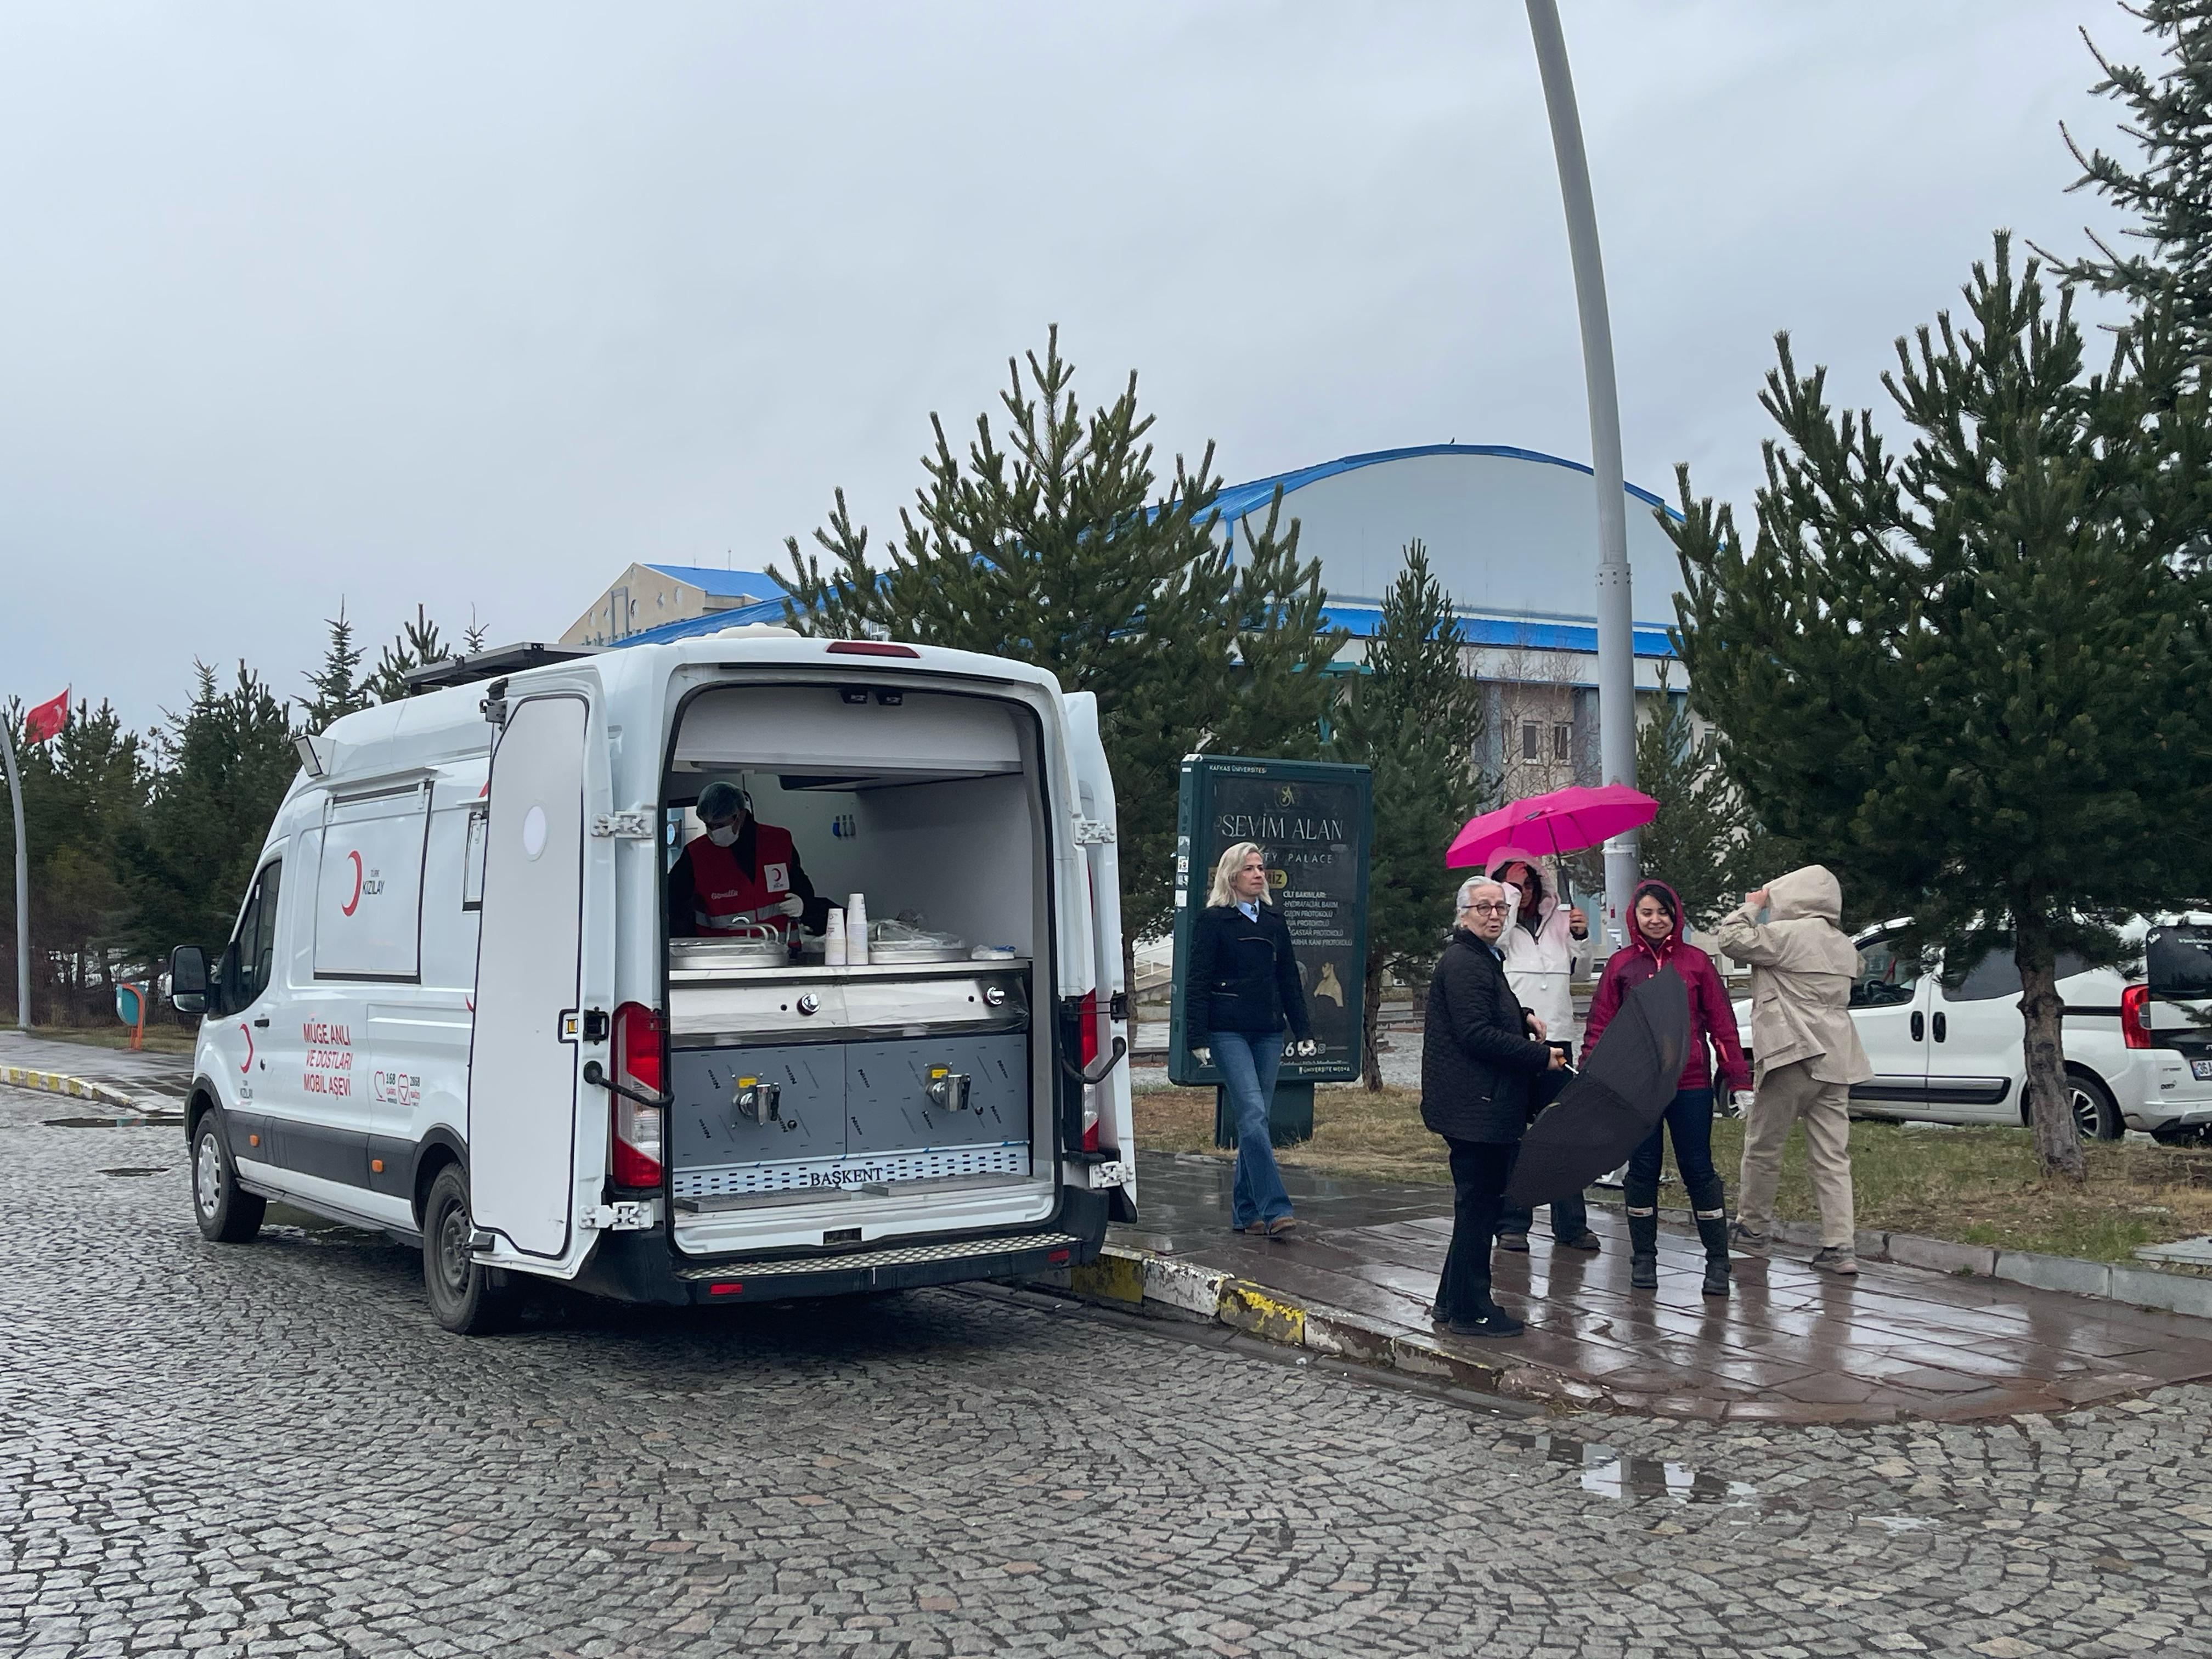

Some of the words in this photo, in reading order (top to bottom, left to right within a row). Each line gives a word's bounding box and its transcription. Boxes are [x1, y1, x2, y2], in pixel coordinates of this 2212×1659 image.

[1221, 813, 1284, 839] SEVİM
[1291, 818, 1344, 840] ALAN
[1289, 853, 1332, 864] PALACE
[363, 880, 385, 895] KIZILAY
[303, 1018, 329, 1045] MÜGE
[331, 1024, 352, 1046] ANLI
[306, 1049, 316, 1067] VE
[316, 1050, 353, 1070] DOSTLARI
[386, 1073, 396, 1085] 168
[708, 1069, 721, 1090] Nitto
[785, 1064, 797, 1085] Nitto
[858, 1069, 870, 1088] Nitto
[303, 1071, 327, 1094] MOBİL
[329, 1074, 351, 1101] AŞEVİ
[699, 1119, 712, 1139] Nitto
[851, 1116, 862, 1136] Nitto
[810, 1167, 883, 1189] BAŞKENT
